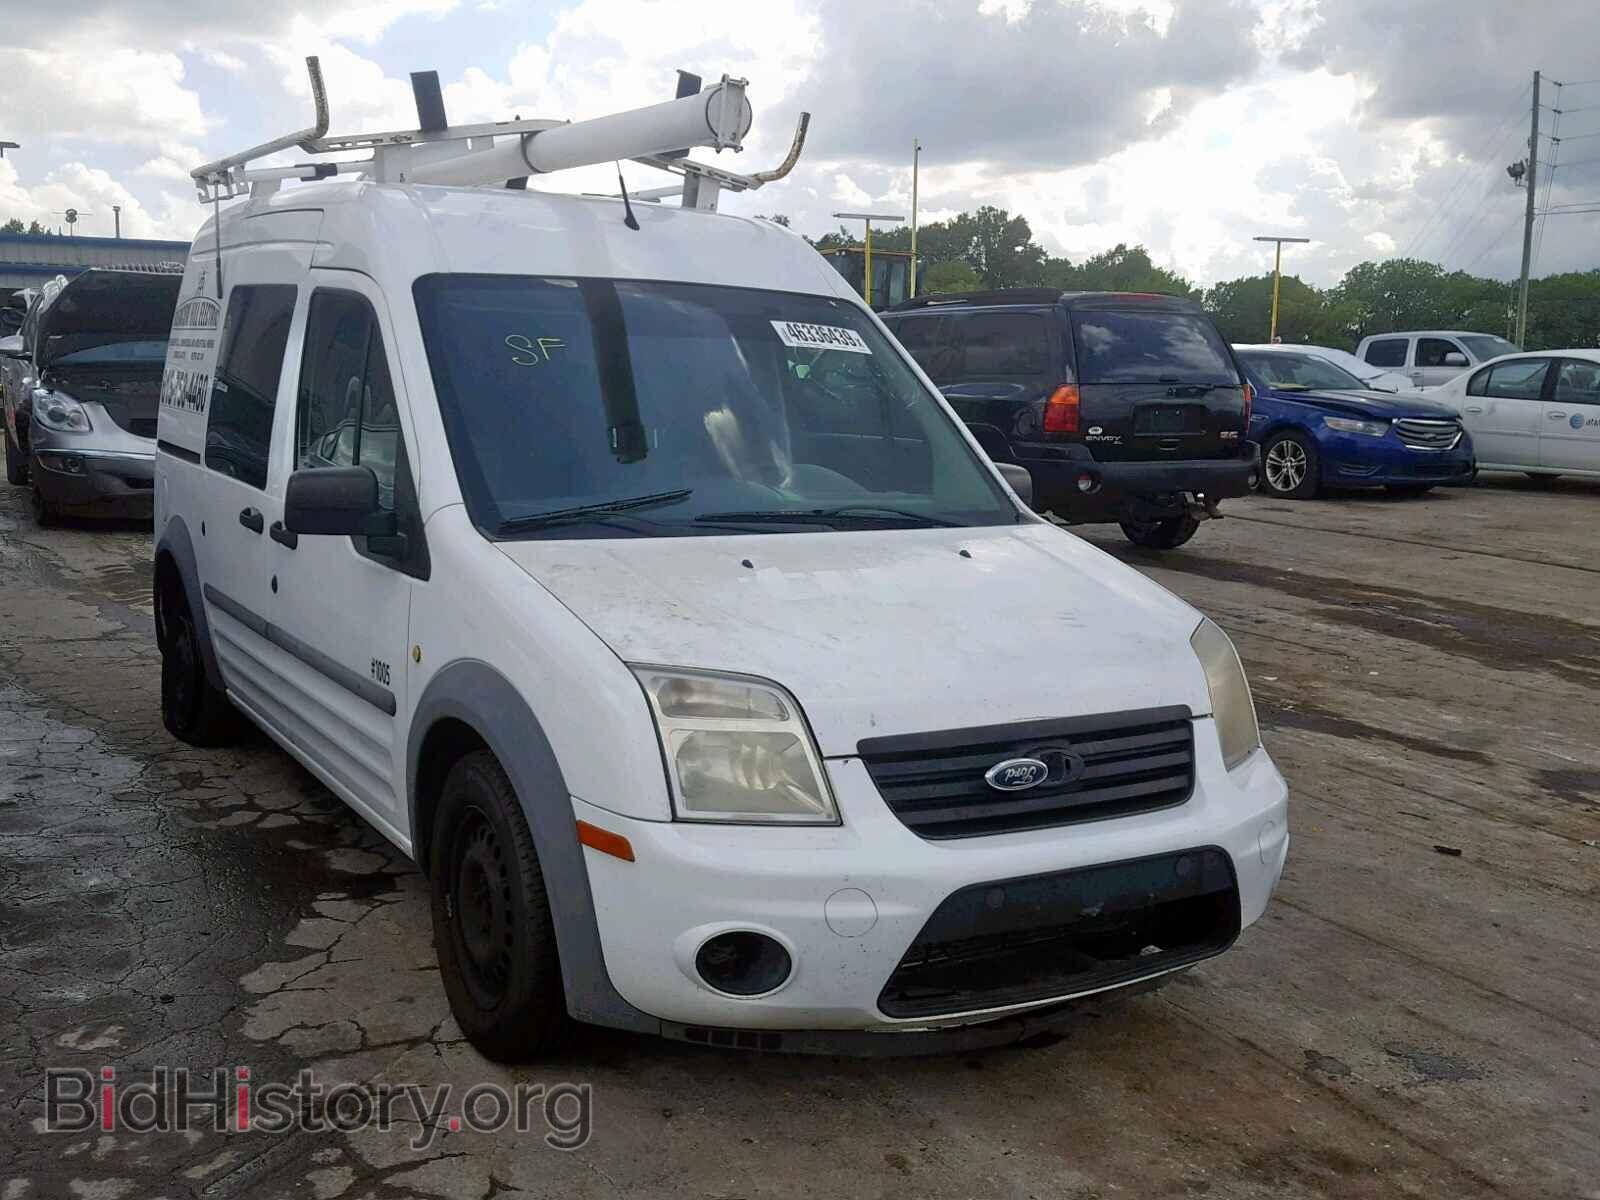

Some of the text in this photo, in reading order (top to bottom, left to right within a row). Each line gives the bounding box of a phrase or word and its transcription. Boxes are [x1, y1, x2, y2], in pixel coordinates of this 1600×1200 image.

[785, 322, 857, 346] 46336439
[504, 334, 567, 366] SF
[371, 657, 390, 686] #1005
[1004, 765, 1037, 784] Ford
